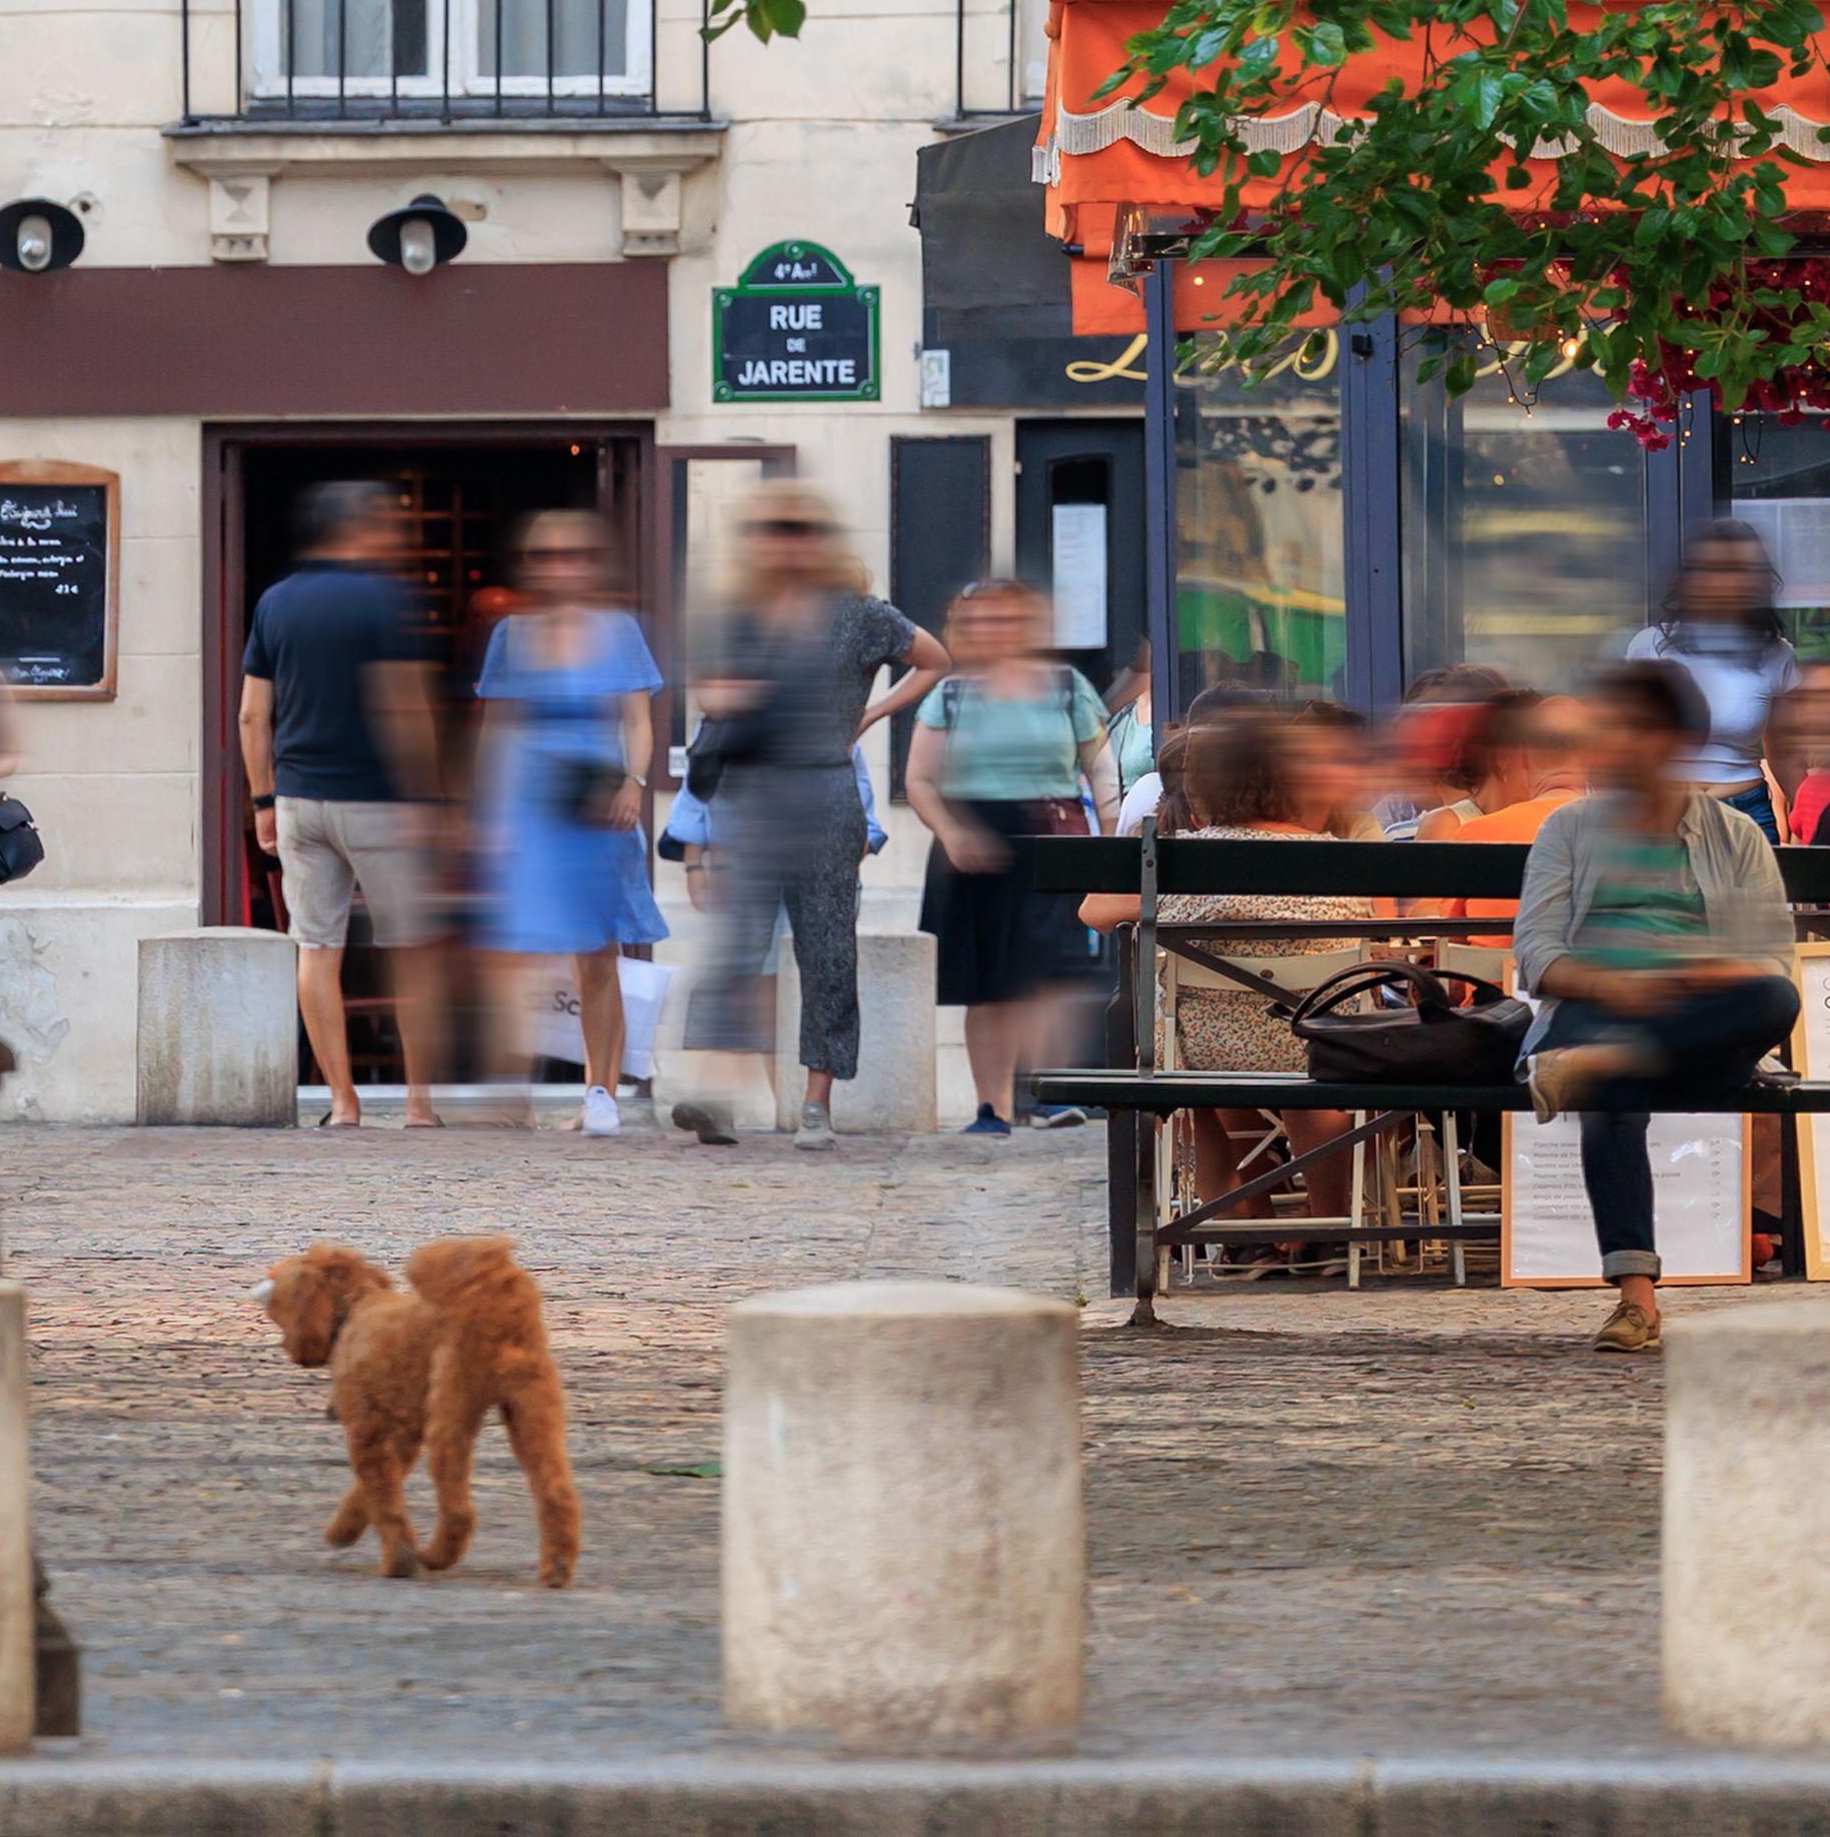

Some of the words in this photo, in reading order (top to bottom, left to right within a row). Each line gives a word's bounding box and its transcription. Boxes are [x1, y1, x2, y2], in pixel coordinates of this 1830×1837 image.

[769, 304, 823, 330] RUE
[786, 337, 807, 353] DE
[737, 359, 856, 386] JARENTE
